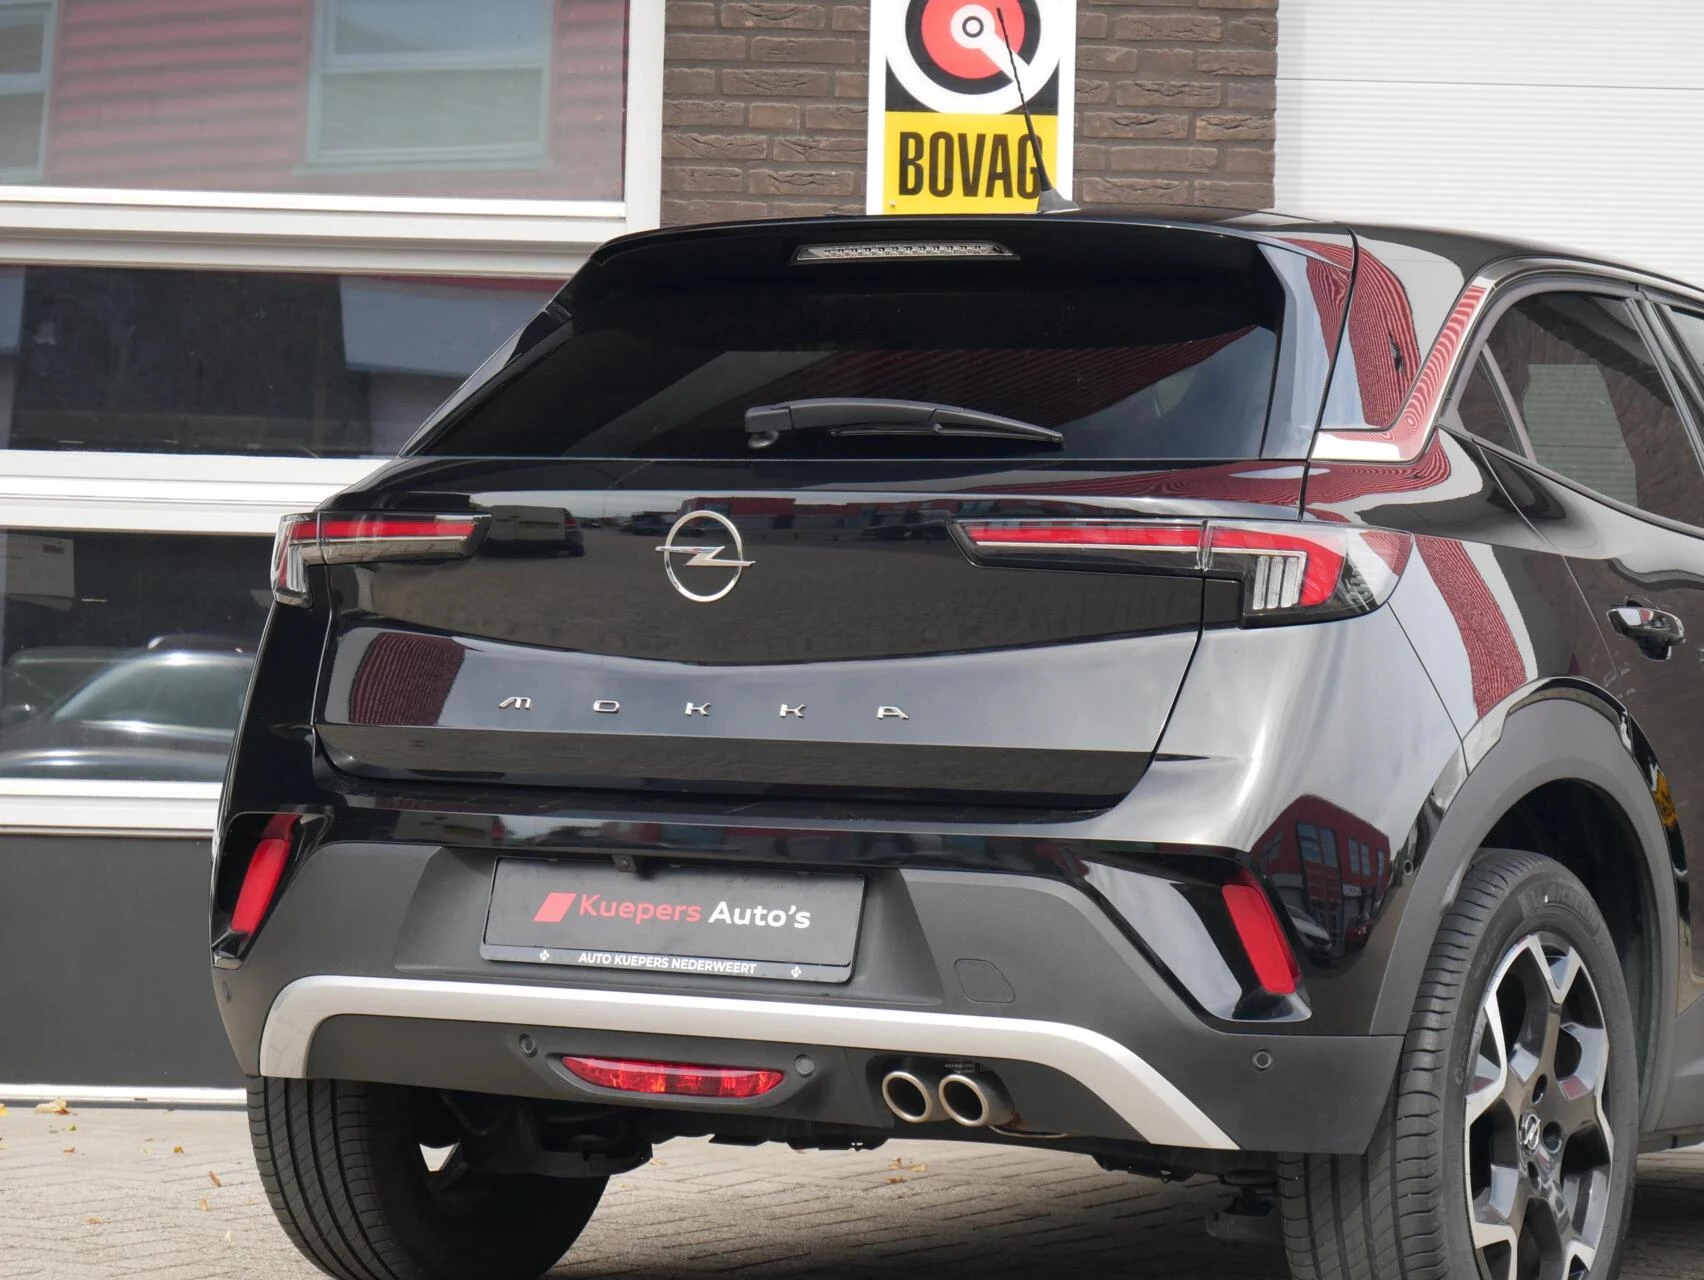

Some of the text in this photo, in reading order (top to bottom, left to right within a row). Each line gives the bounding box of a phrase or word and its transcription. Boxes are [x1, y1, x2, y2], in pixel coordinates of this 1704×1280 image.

[898, 131, 1043, 199] BOVAG
[499, 696, 909, 719] MOKKA
[579, 894, 811, 928] Kuepers Auto’s
[579, 953, 757, 974] AUTO KUEPERS NEDERWEERT
